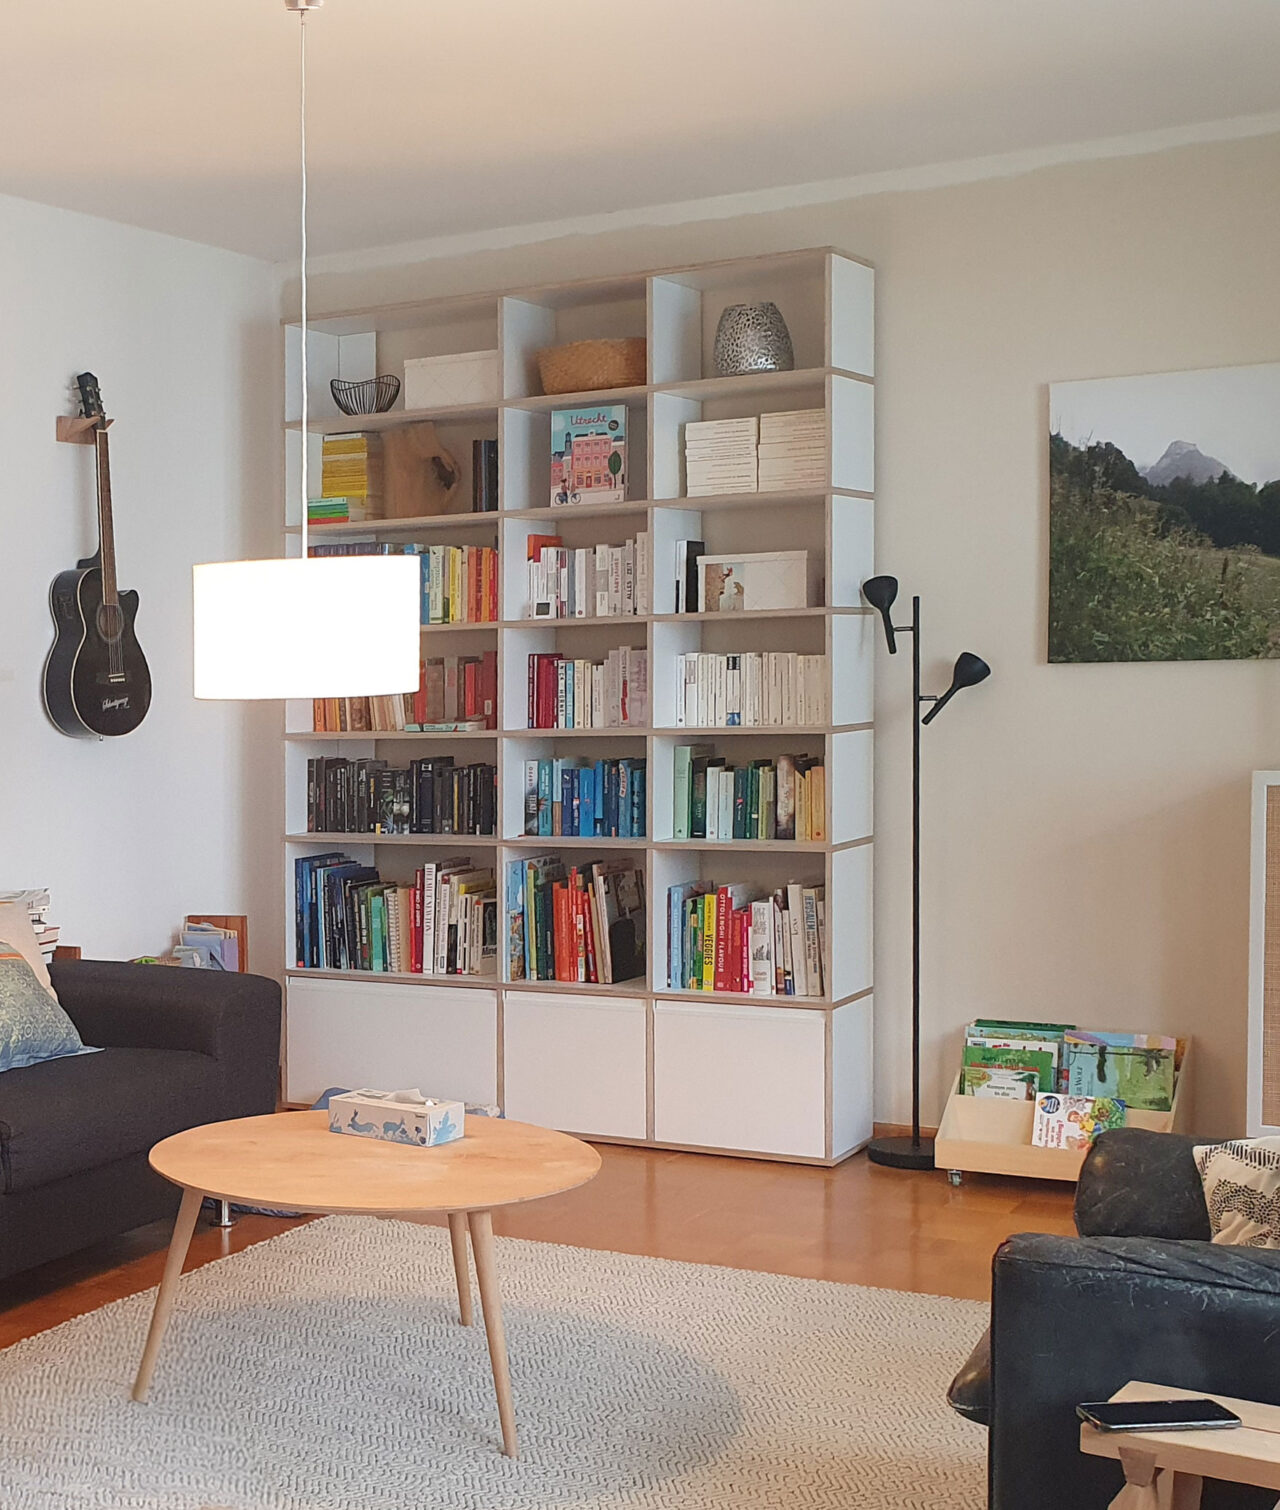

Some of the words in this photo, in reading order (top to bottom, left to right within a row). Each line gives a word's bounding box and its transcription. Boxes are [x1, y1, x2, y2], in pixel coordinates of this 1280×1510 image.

[570, 412, 608, 426] Utrecht
[425, 867, 434, 897] HELMUT
[425, 897, 434, 933] NEWTON
[805, 895, 815, 930] JERUSALEM
[704, 933, 713, 966] VEGGIES
